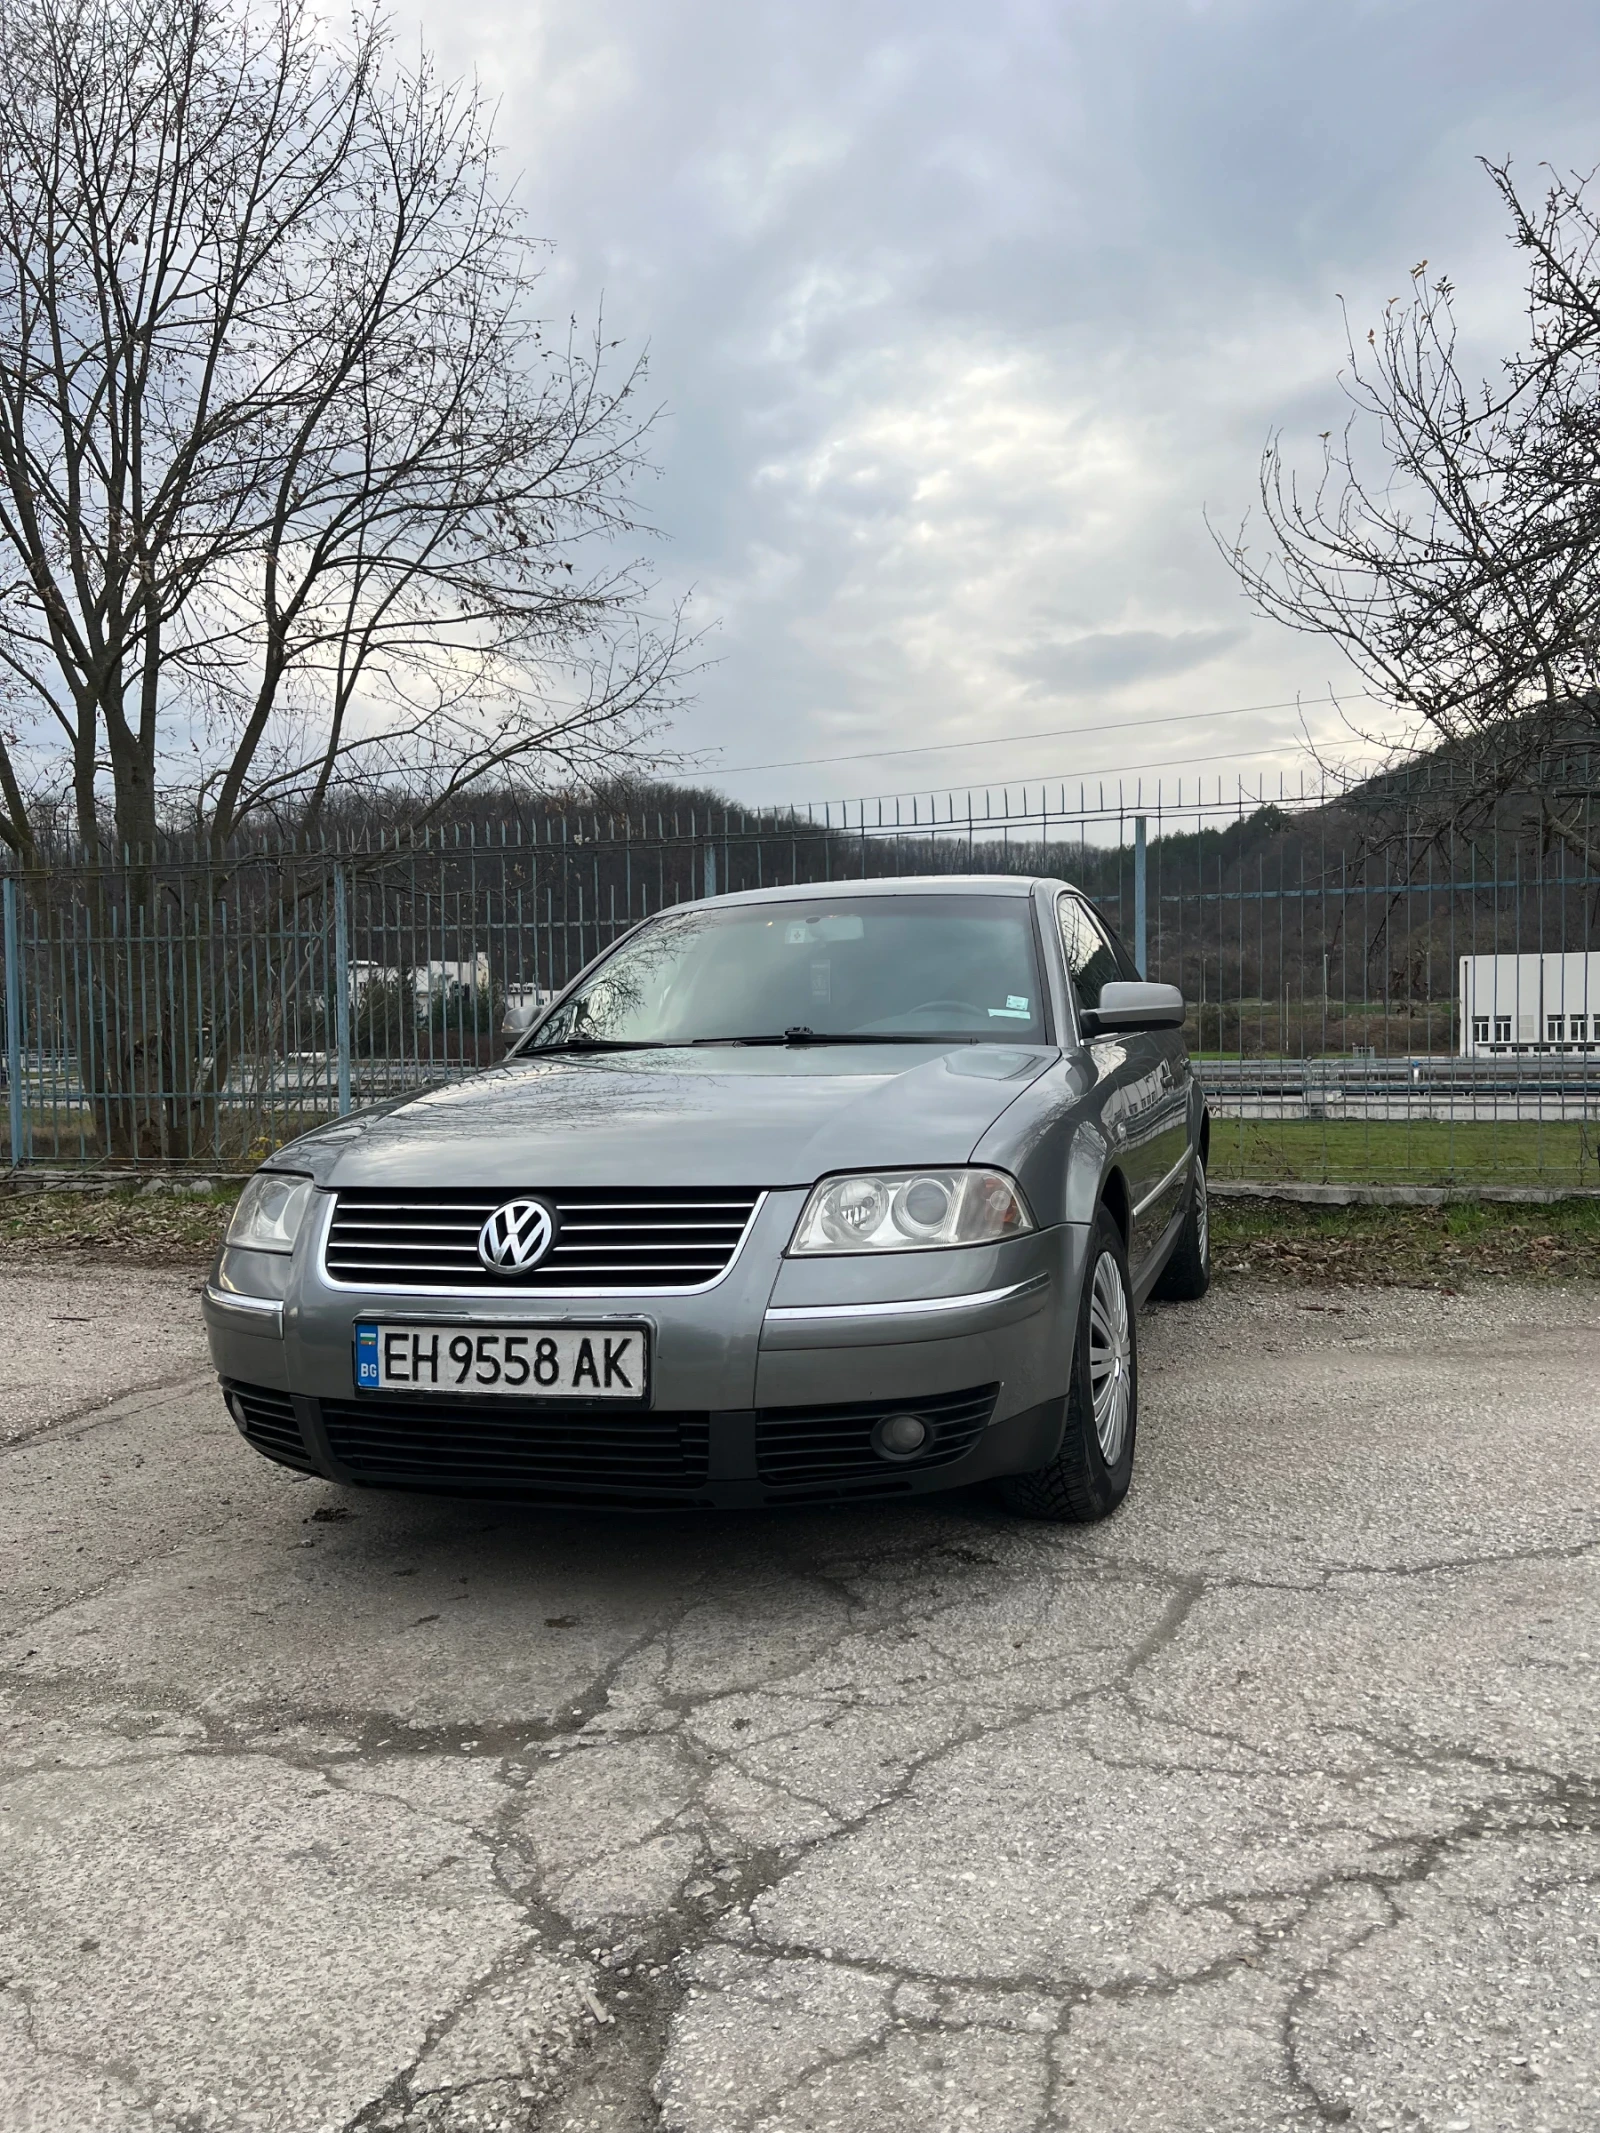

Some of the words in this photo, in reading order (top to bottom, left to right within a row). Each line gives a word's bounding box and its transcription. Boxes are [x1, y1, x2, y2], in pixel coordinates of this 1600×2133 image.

[480, 1201, 551, 1272] VW
[360, 1363, 377, 1377] BG
[384, 1332, 439, 1383] EH
[448, 1335, 560, 1387] 9558
[571, 1337, 633, 1388] AK
